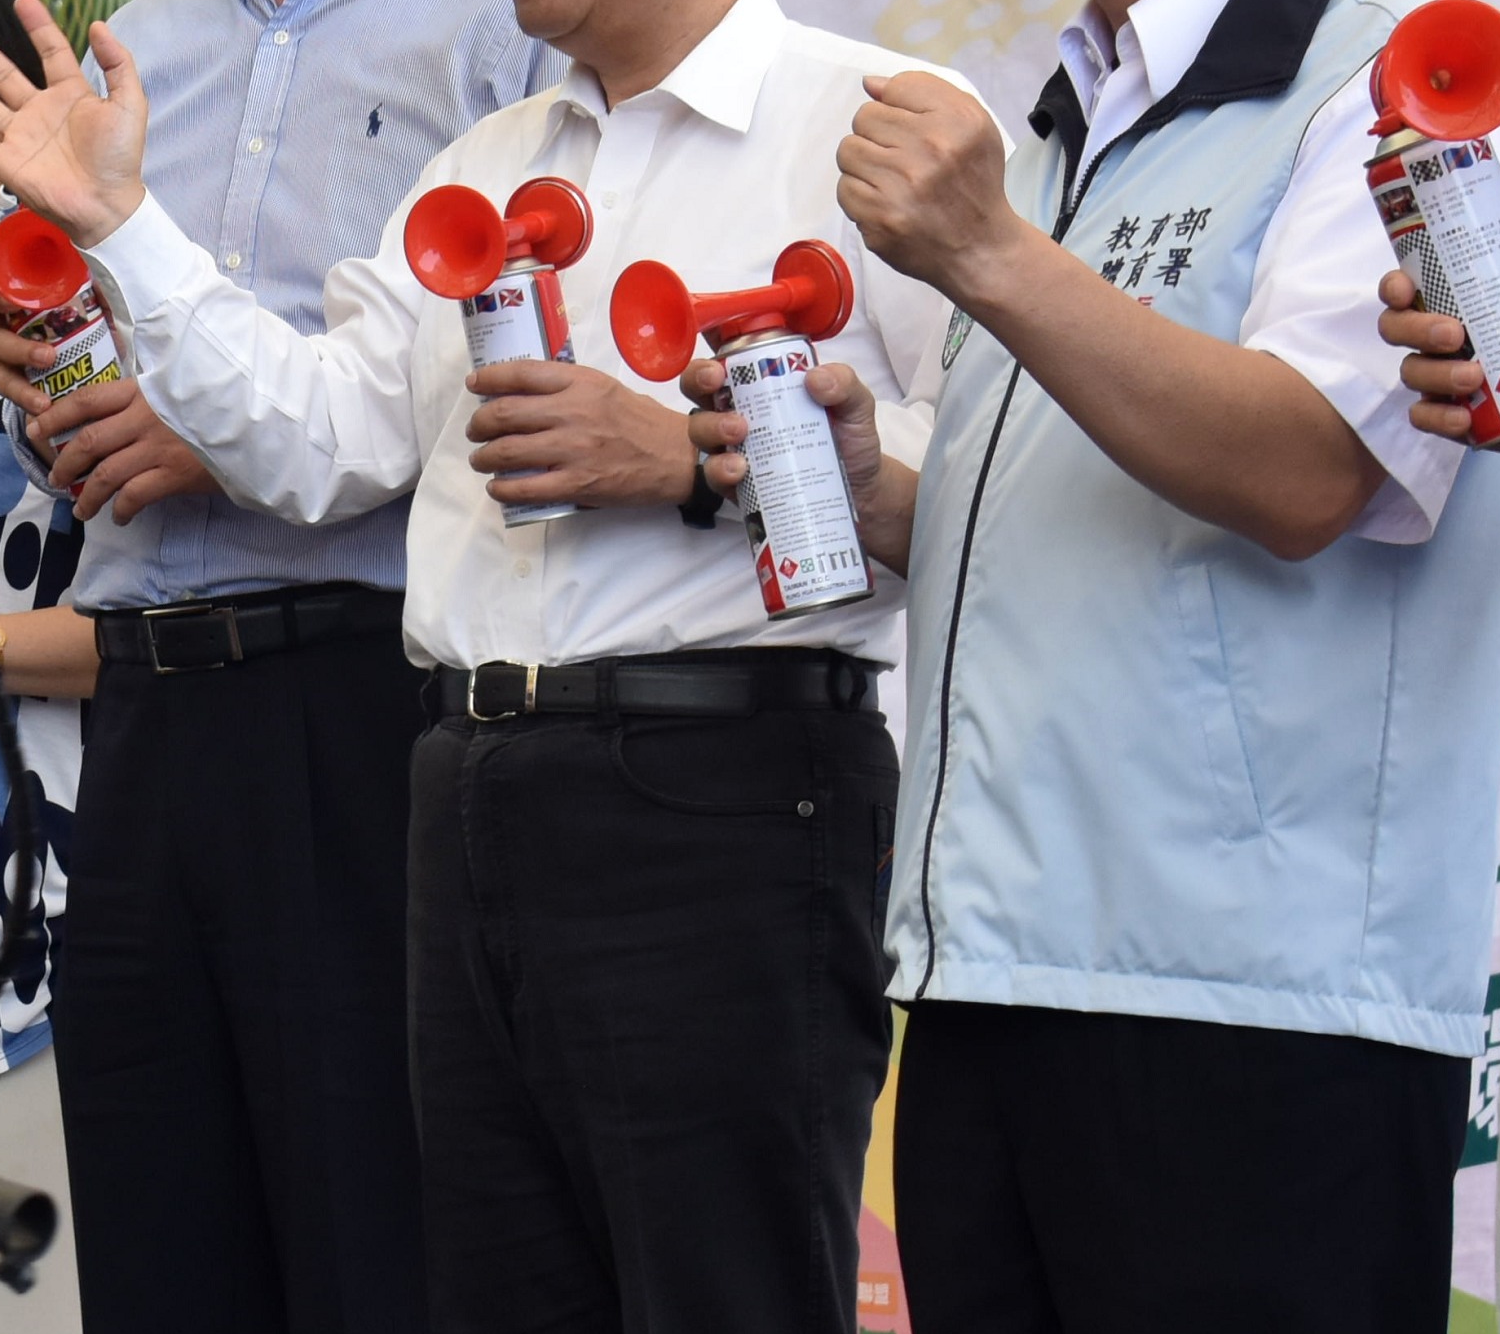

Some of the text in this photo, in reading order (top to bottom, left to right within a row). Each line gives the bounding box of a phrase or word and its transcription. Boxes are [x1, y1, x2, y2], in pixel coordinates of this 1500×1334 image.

[1105, 207, 1212, 253] 教育部
[47, 353, 94, 400] TONE
